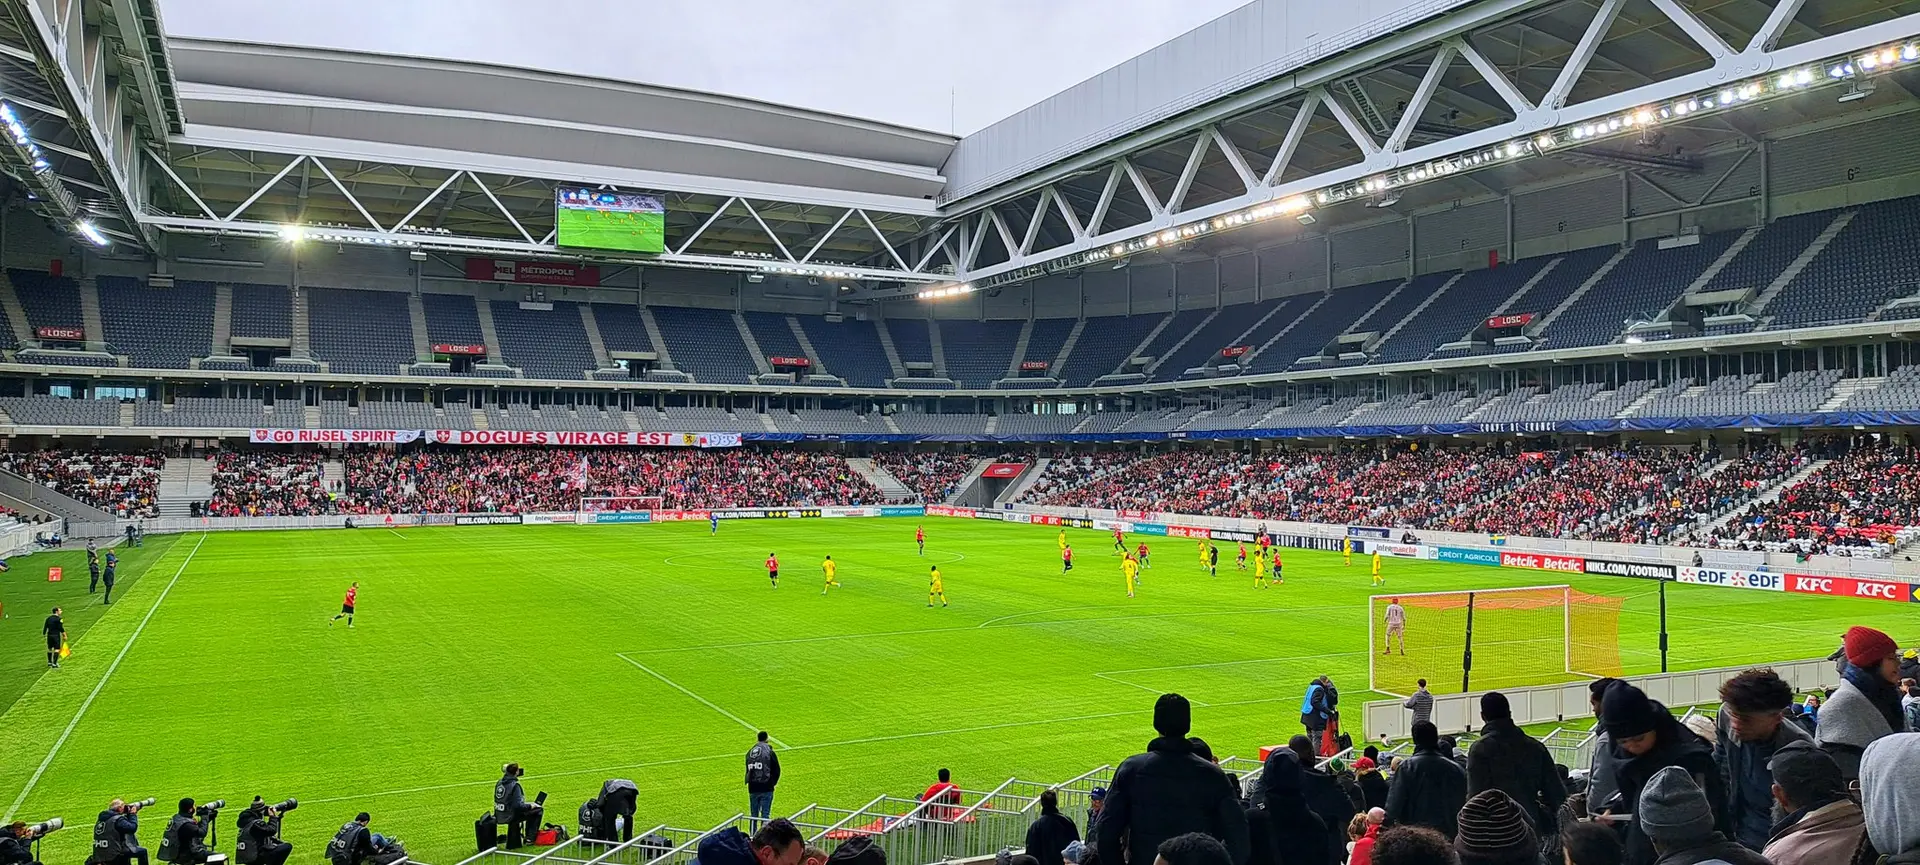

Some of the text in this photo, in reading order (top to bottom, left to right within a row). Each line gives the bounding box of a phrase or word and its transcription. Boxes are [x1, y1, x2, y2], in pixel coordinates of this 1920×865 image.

[521, 266, 575, 276] MÉTROPOLE
[1502, 316, 1521, 325] LOSC
[47, 329, 74, 337] LOSC
[274, 430, 397, 442] GO RIJSEL SPIRIT
[461, 431, 672, 445] DOGUES VIRAGE EST
[456, 515, 521, 525] NIKE.COM/FOOTBALL
[682, 511, 708, 521] Betclic
[1168, 526, 1209, 539] Betclic Betclic
[1314, 537, 1341, 551] FRANCE
[1439, 550, 1499, 562] CRÉDIT AGRICOLE
[1503, 554, 1581, 571] Betclic Betclic
[1585, 561, 1674, 579] NIKE.COM/FOOTBALL
[1795, 577, 1897, 598] KFC KFC
